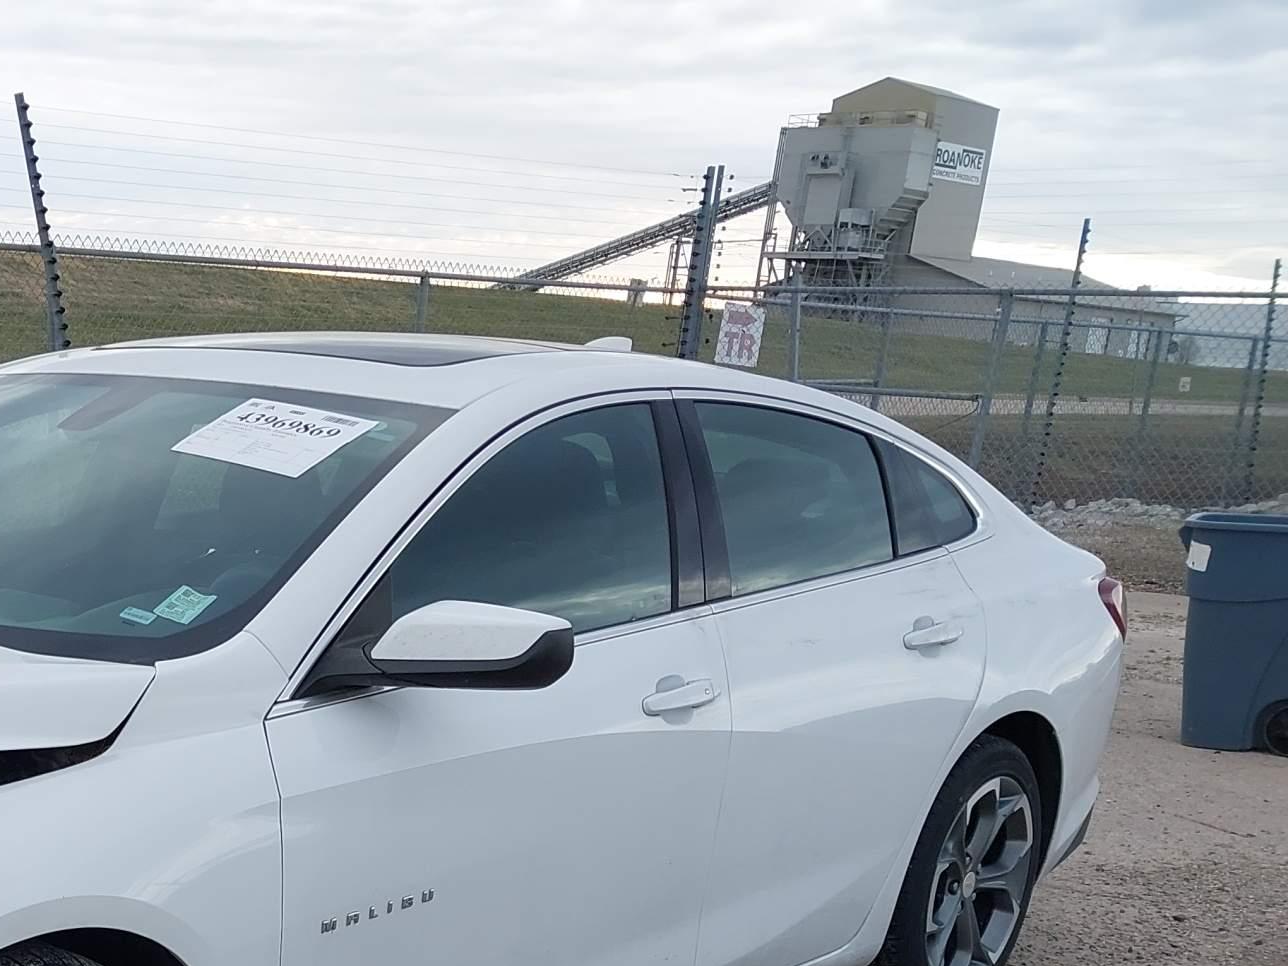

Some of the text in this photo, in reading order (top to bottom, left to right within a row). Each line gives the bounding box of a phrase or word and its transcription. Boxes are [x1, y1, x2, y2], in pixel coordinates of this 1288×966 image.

[936, 148, 983, 170] ROANOKE
[724, 331, 757, 361] TR
[236, 411, 342, 438] 43969869
[320, 888, 435, 934] MALIBU
